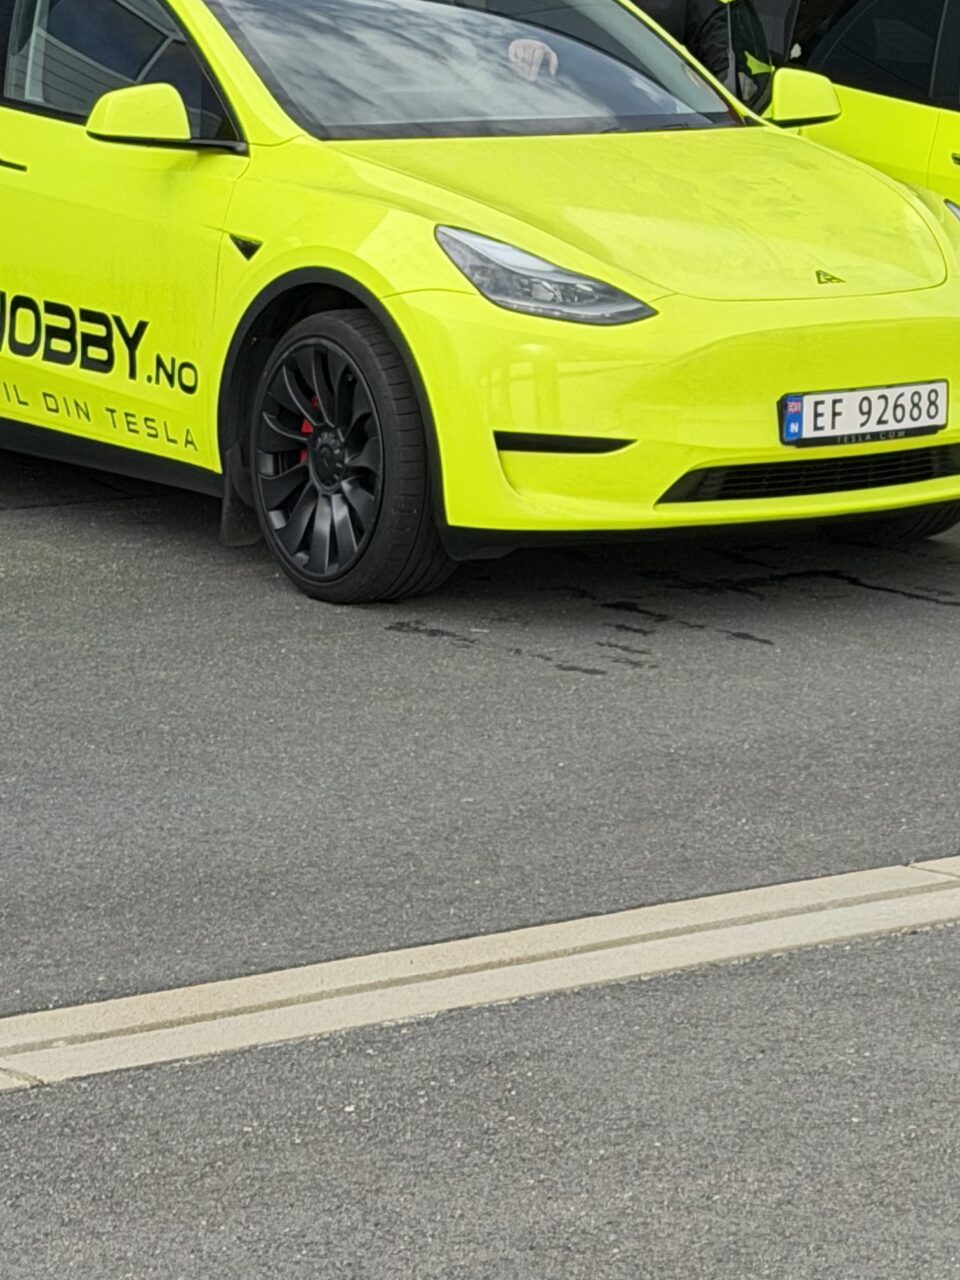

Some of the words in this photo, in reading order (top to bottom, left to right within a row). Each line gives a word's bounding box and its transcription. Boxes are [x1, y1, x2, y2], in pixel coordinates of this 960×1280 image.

[0, 290, 198, 395] OBBY.NO
[3, 381, 29, 406] IL
[42, 391, 91, 422] DIN
[105, 407, 198, 451] TESLA
[813, 399, 843, 432] EF
[858, 389, 939, 428] 92688
[837, 431, 906, 443] TESLA.COM
